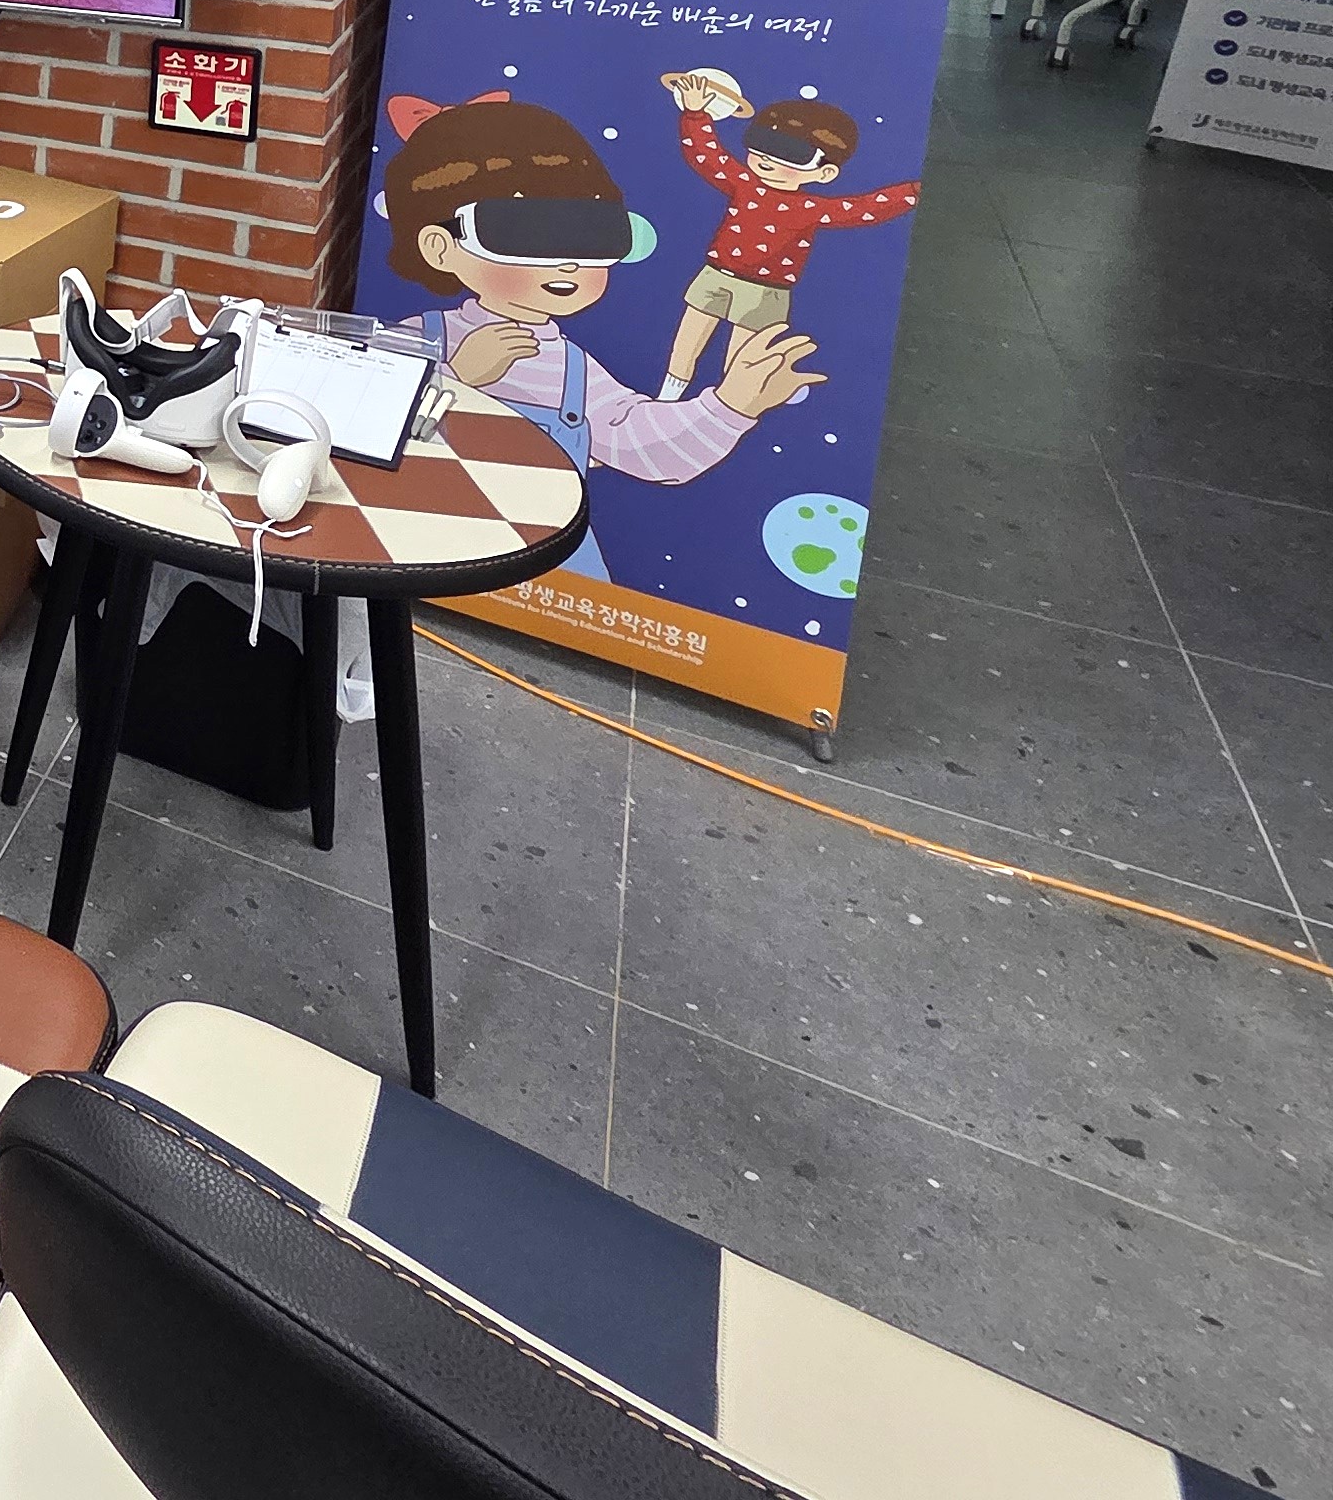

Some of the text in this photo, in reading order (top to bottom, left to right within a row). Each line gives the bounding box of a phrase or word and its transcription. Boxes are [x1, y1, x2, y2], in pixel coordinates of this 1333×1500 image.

[672, 5, 753, 35] 배움의
[764, 16, 833, 44] 여정!
[164, 51, 247, 77] 소화기
